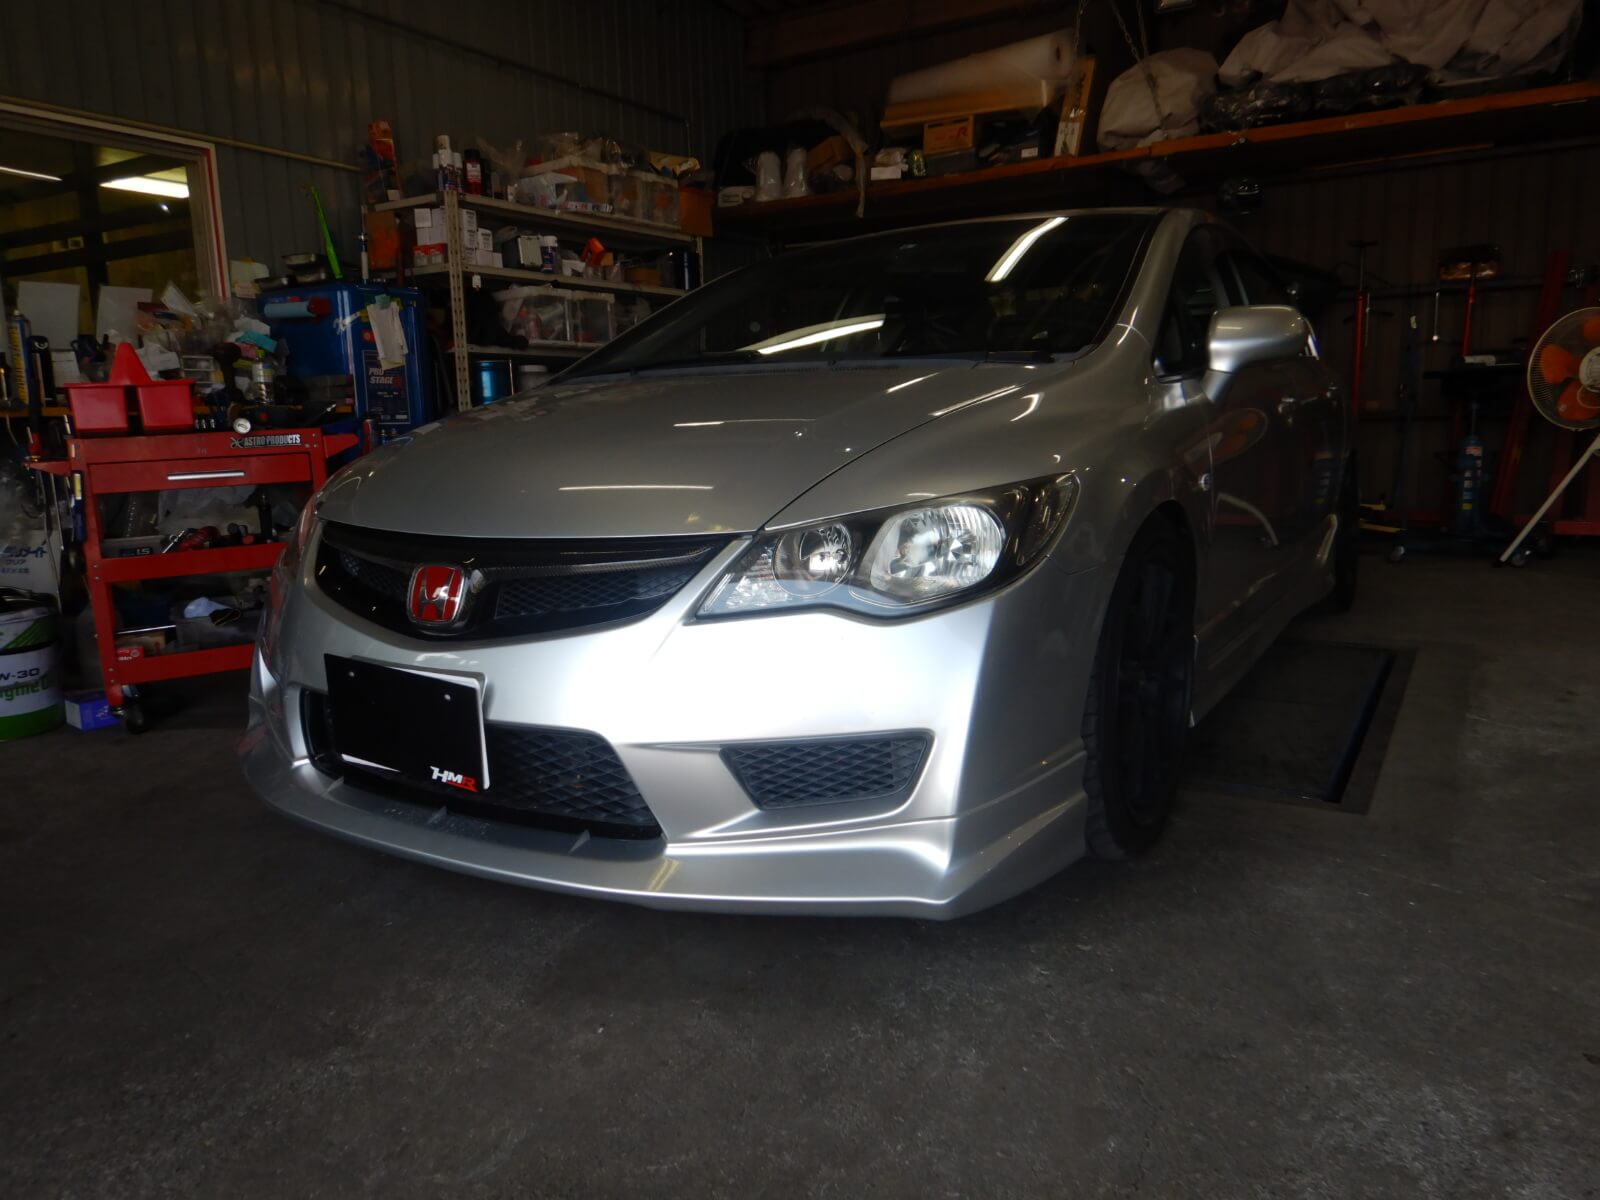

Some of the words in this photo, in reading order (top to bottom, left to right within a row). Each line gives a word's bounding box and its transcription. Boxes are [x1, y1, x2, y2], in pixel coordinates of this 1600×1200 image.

[243, 436, 266, 447] ASTRO
[266, 433, 301, 446] PRODUCTS
[430, 765, 481, 793] HMR
